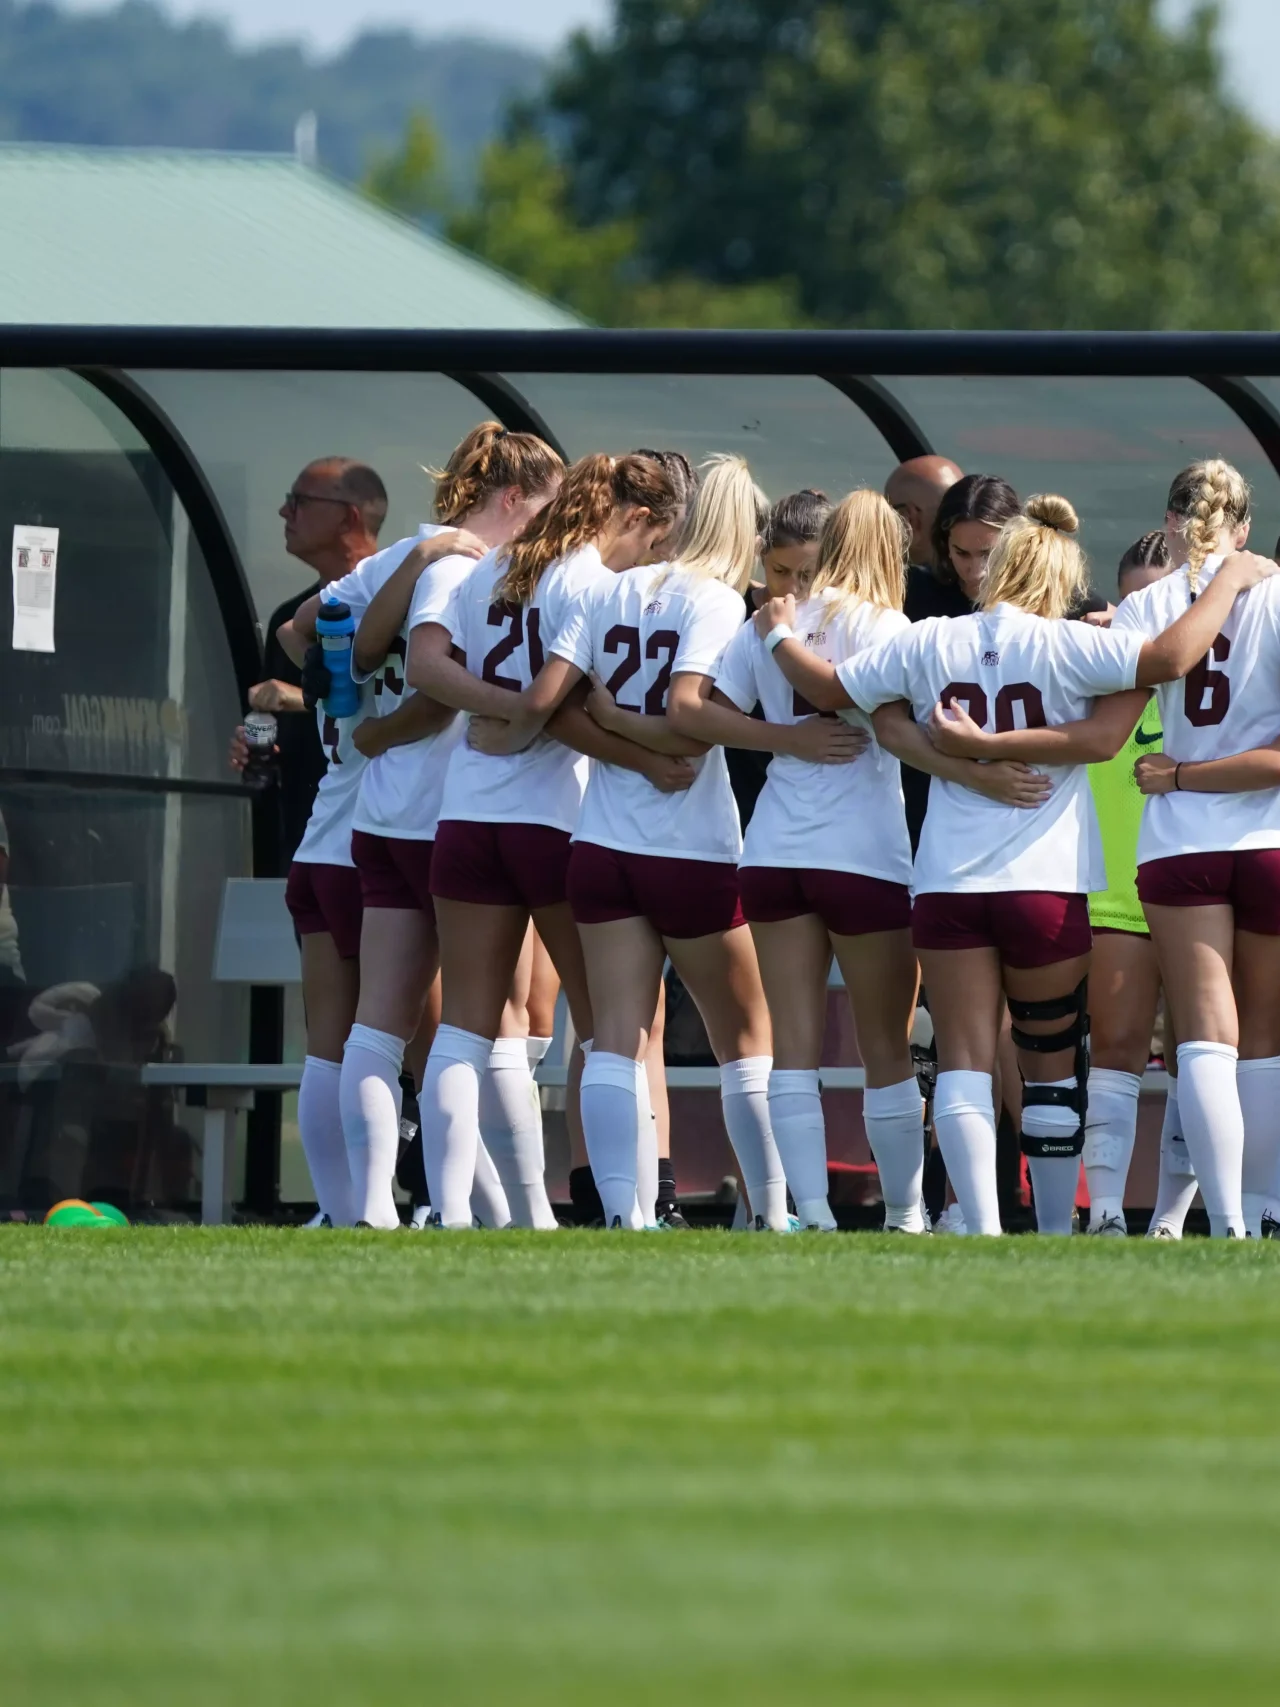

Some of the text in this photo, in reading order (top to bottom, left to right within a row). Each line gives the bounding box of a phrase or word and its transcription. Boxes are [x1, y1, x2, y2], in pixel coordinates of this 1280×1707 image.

[482, 599, 545, 692] 21
[603, 623, 680, 716] 22
[1184, 631, 1230, 727] 6
